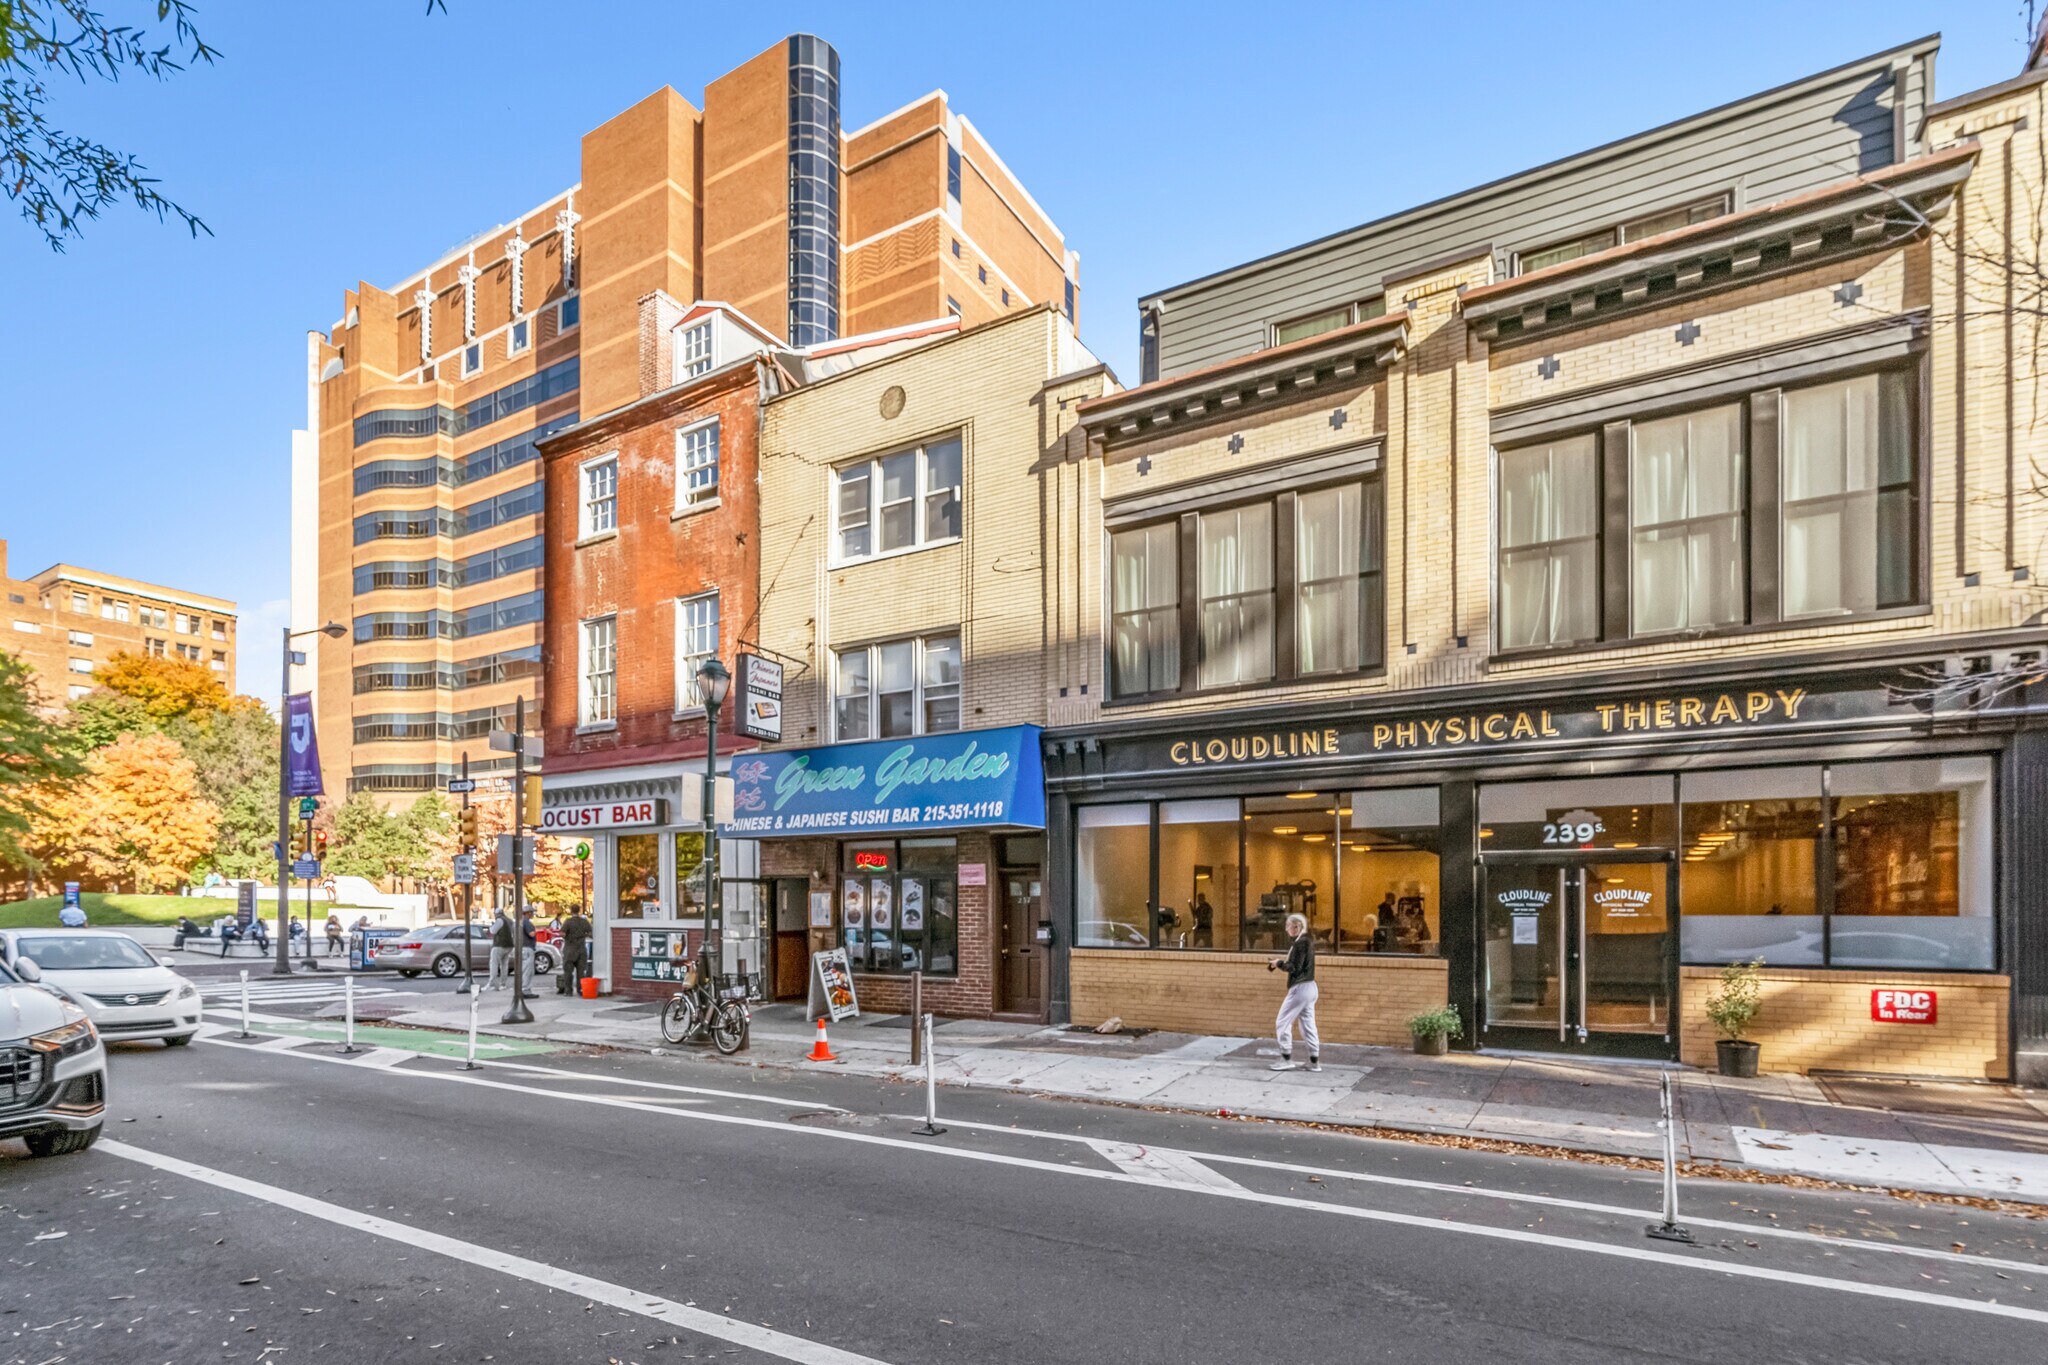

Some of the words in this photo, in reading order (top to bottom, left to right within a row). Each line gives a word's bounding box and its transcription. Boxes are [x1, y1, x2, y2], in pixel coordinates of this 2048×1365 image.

[751, 660, 774, 675] Chinese
[750, 671, 778, 687] Japanese
[748, 685, 766, 696] SUSHI
[768, 691, 780, 700] BAR
[1170, 729, 1340, 766] CLOUDLINE
[1373, 710, 1560, 749] PHYSICAL
[1596, 688, 1808, 732] THERAPY
[773, 755, 866, 811] Green
[875, 740, 1010, 804] Garden
[542, 807, 604, 828] OCUST
[612, 803, 652, 823] BAR
[775, 815, 783, 829] &
[786, 811, 848, 828] JAPANESE
[850, 809, 889, 825] SUSHI
[892, 807, 920, 823] BAR
[923, 801, 1003, 822] 215-351-1118
[1543, 823, 1595, 843] 239
[1498, 889, 1552, 903] CLOUDLINE
[1593, 889, 1652, 903] CLOUDLINE
[1878, 991, 1931, 1009] FDC
[1896, 1009, 1928, 1019] Rear
